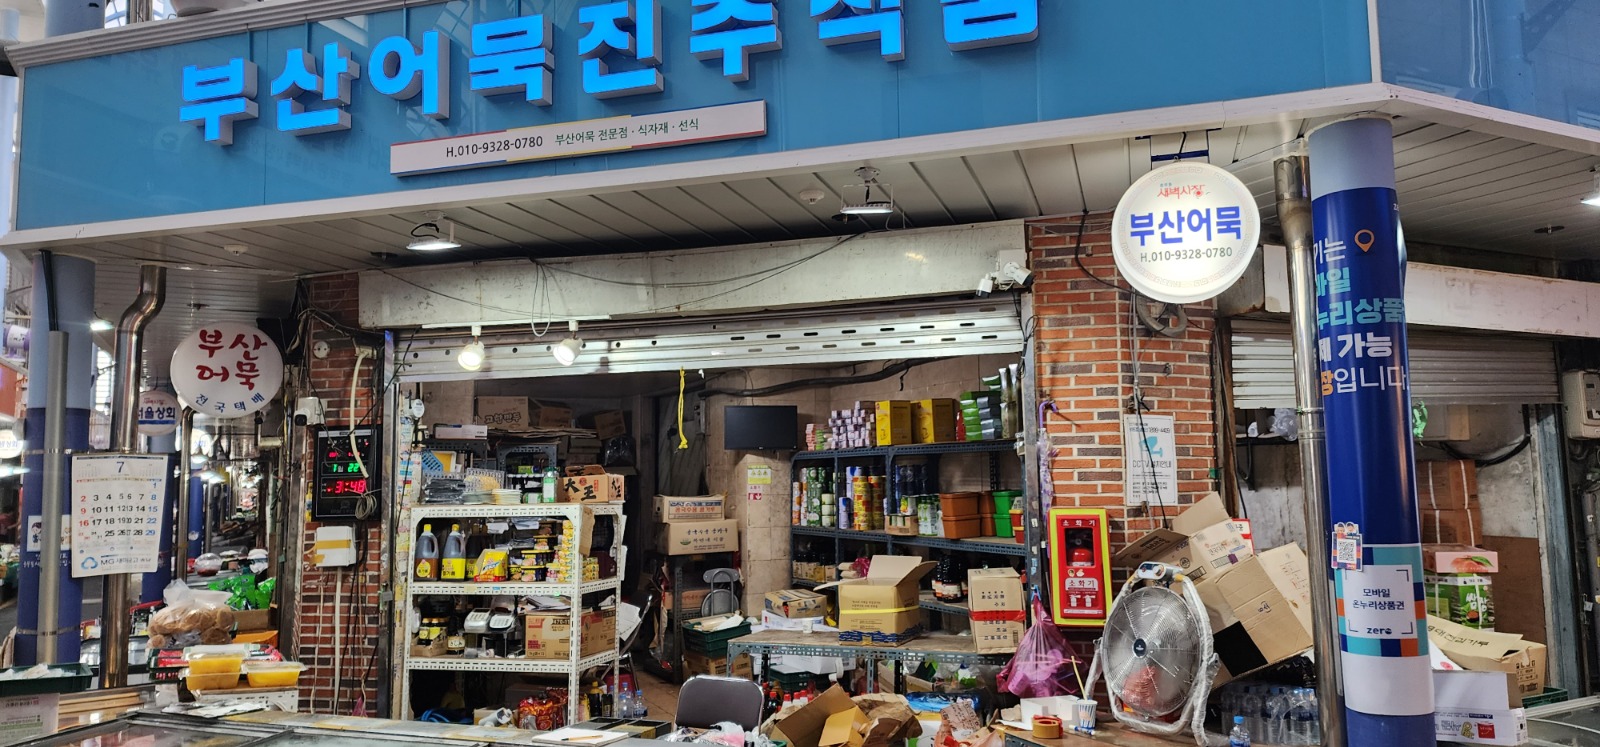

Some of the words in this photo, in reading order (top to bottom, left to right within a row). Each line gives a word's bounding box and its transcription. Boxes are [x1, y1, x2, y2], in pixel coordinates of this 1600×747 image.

[446, 136, 543, 158] H.010-9328-0780
[555, 132, 595, 147] 부산어묵
[598, 127, 628, 142] 전문점
[638, 121, 669, 137] 식자재
[678, 118, 699, 132] 선식
[1130, 206, 1241, 246] 부산어묵
[1140, 247, 1233, 263] H.010-9328-0780
[198, 329, 267, 361] 부산
[1338, 332, 1392, 358] 가능
[196, 361, 260, 391] 어묵
[195, 393, 265, 413] 전국택배
[116, 461, 125, 473] 7
[348, 463, 360, 472] 22
[1363, 588, 1390, 598] 모바일
[1352, 600, 1405, 611] 온누리상품권
[1366, 627, 1393, 635] zero
